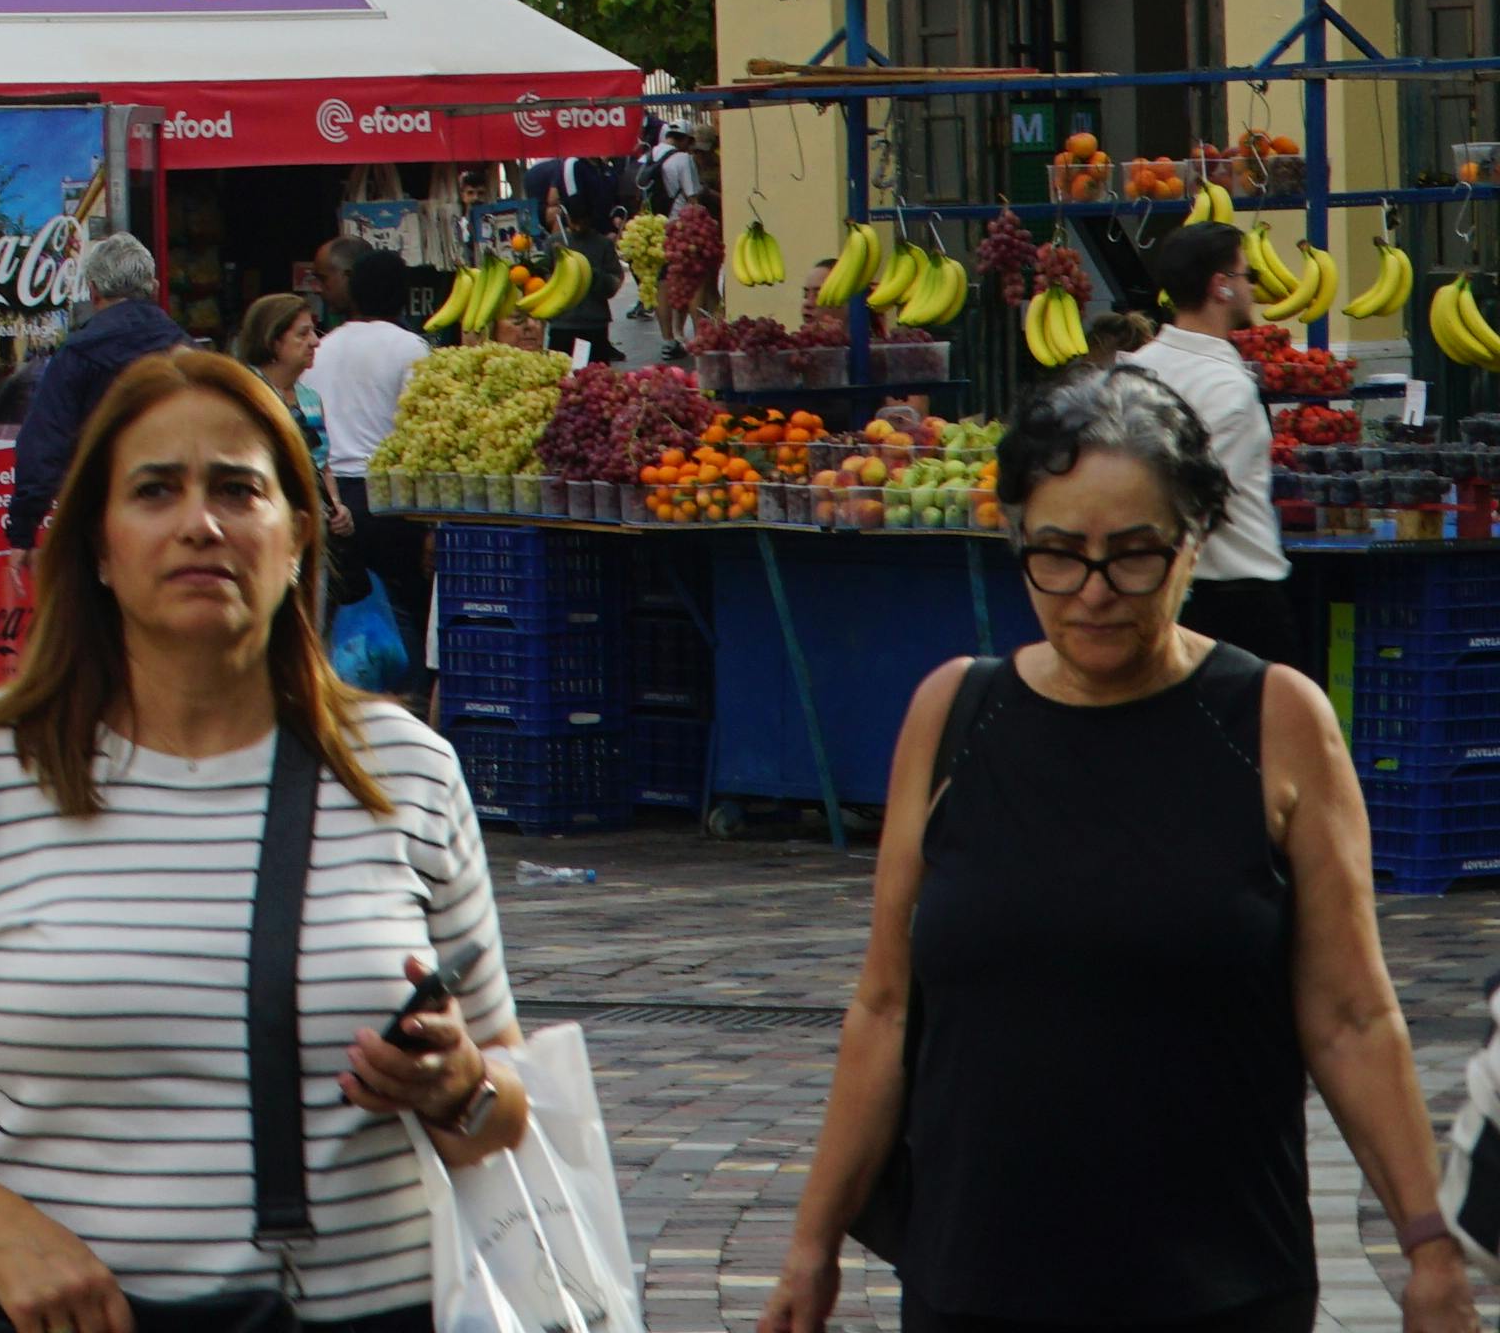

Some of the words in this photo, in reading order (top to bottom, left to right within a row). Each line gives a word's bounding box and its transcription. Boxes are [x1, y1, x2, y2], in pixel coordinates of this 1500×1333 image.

[164, 110, 233, 139] efood
[359, 106, 431, 134] efood
[1011, 113, 1044, 143] M
